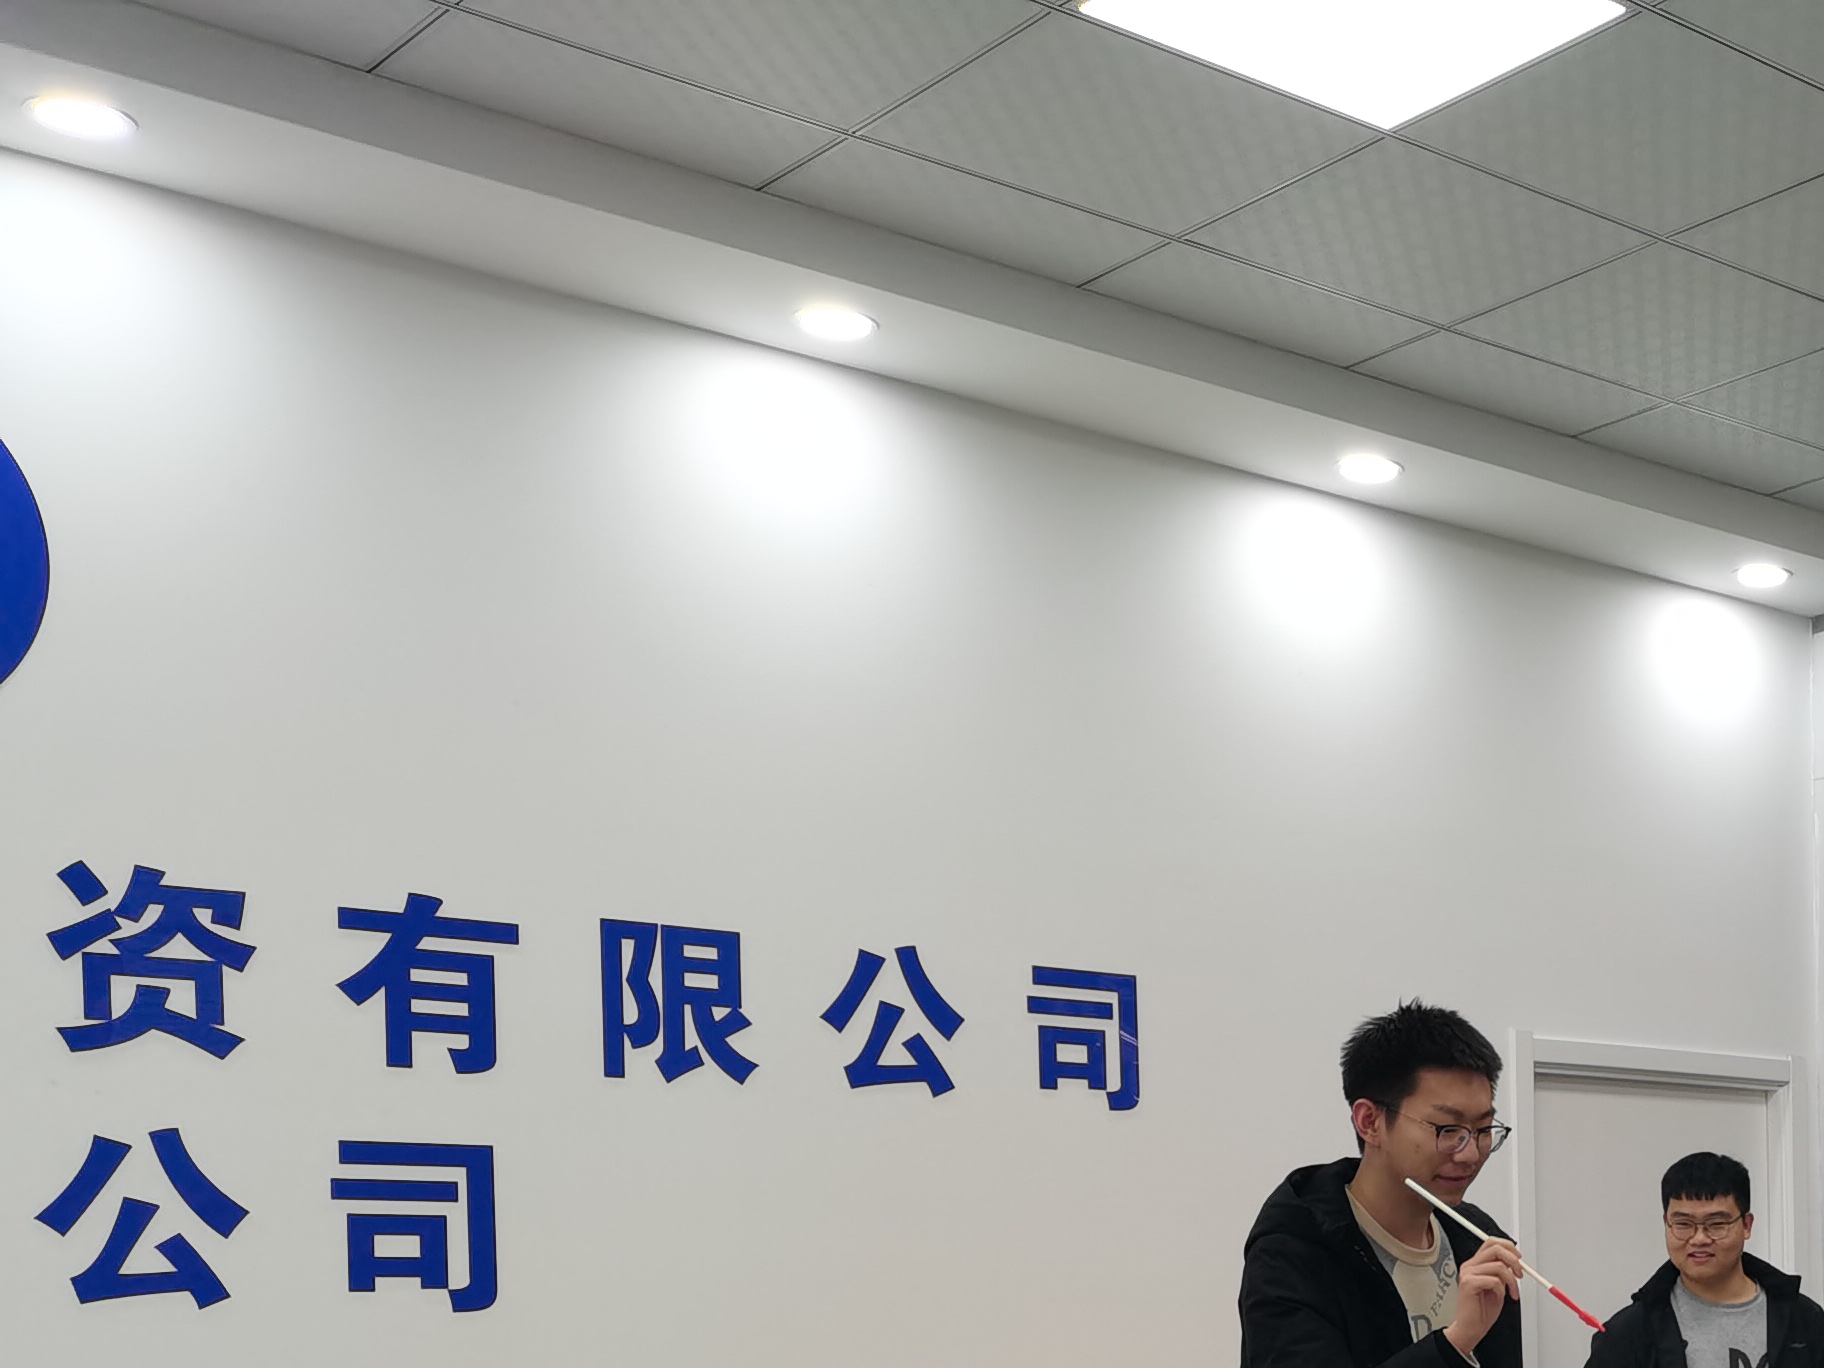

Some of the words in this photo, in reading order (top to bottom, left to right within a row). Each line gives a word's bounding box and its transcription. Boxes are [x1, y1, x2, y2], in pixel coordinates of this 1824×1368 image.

[47, 860, 1140, 1111] 资有限公司
[34, 1127, 498, 1312] 公司
